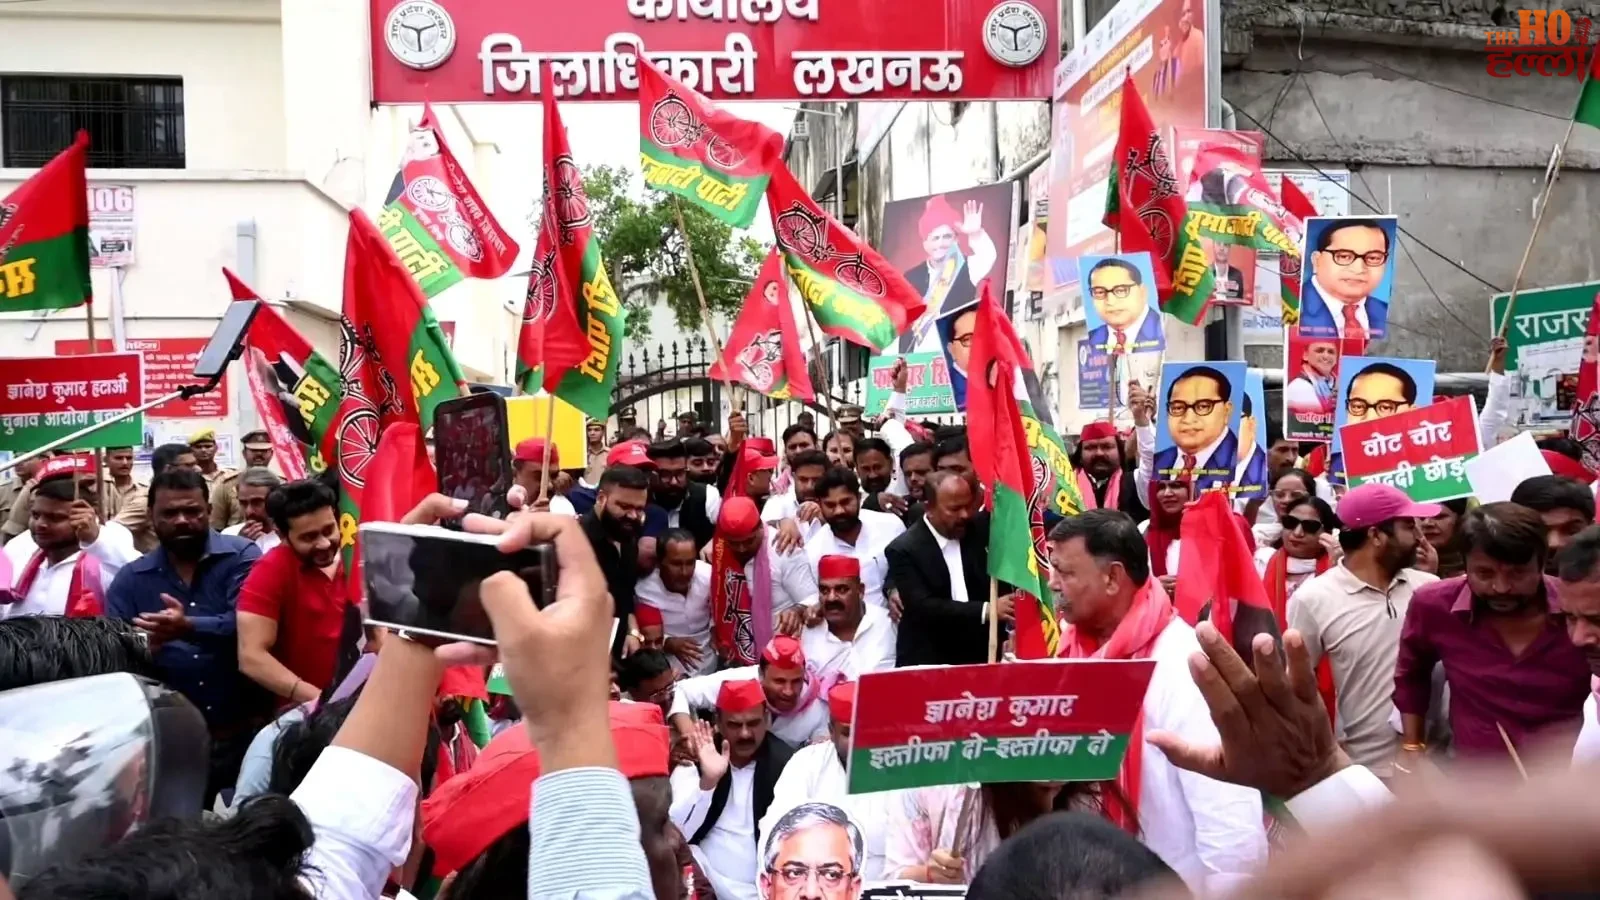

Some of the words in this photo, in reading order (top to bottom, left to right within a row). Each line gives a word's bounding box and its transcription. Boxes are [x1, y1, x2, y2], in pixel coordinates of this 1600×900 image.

[791, 51, 965, 95] लखनऊ
[52, 380, 88, 404] कुमार
[45, 405, 91, 427] आयोग
[1361, 432, 1403, 456] वोट
[1407, 420, 1452, 446] चोर
[925, 691, 1003, 724] ज्ञानेश
[1009, 694, 1078, 727] कुमार
[869, 735, 955, 770] इस्तीफा
[1087, 728, 1115, 758] दो
